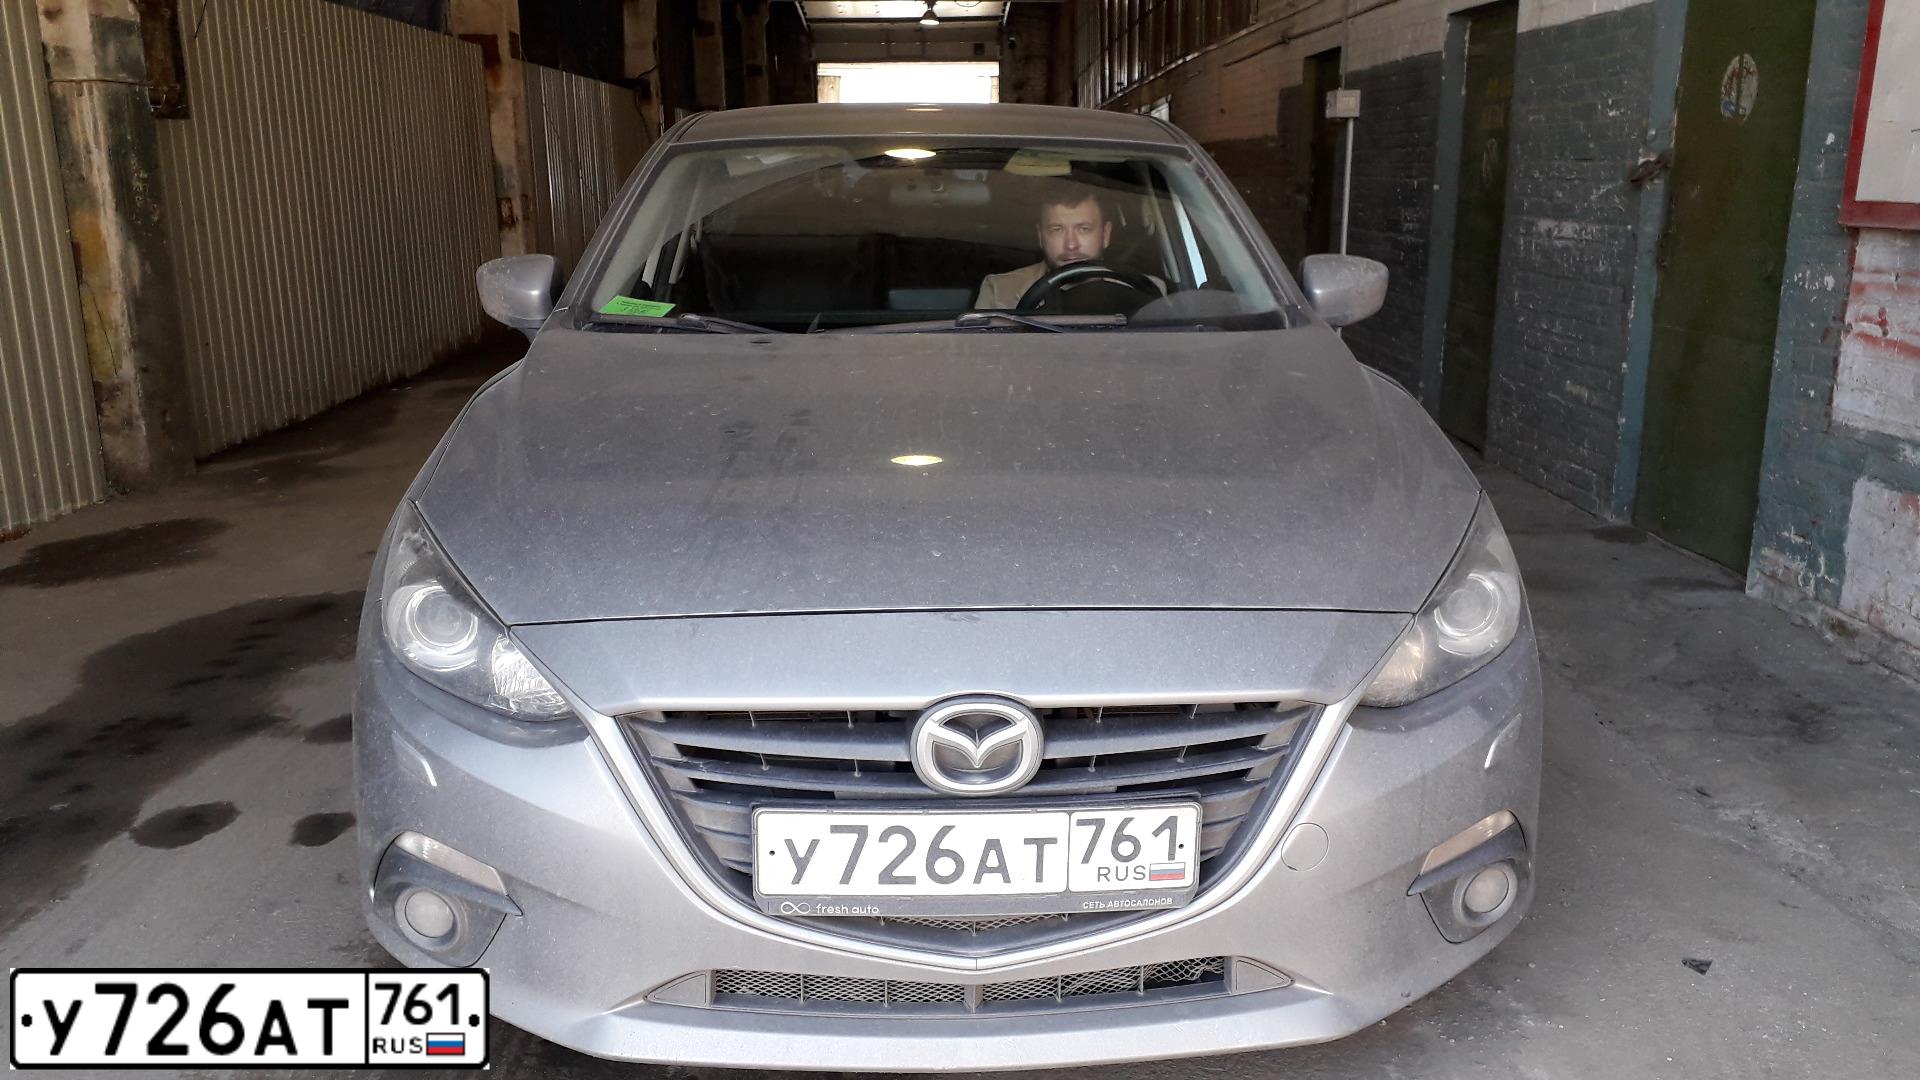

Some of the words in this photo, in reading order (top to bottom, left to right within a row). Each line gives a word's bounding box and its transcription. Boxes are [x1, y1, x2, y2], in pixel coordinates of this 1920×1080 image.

[1076, 816, 1178, 865] 761
[1098, 865, 1146, 882] RUS
[816, 904, 849, 914] fresh
[851, 904, 880, 914] auto
[1082, 901, 1106, 909] СЕТЬ
[1107, 897, 1173, 908] АВТОСАЛОНОВ
